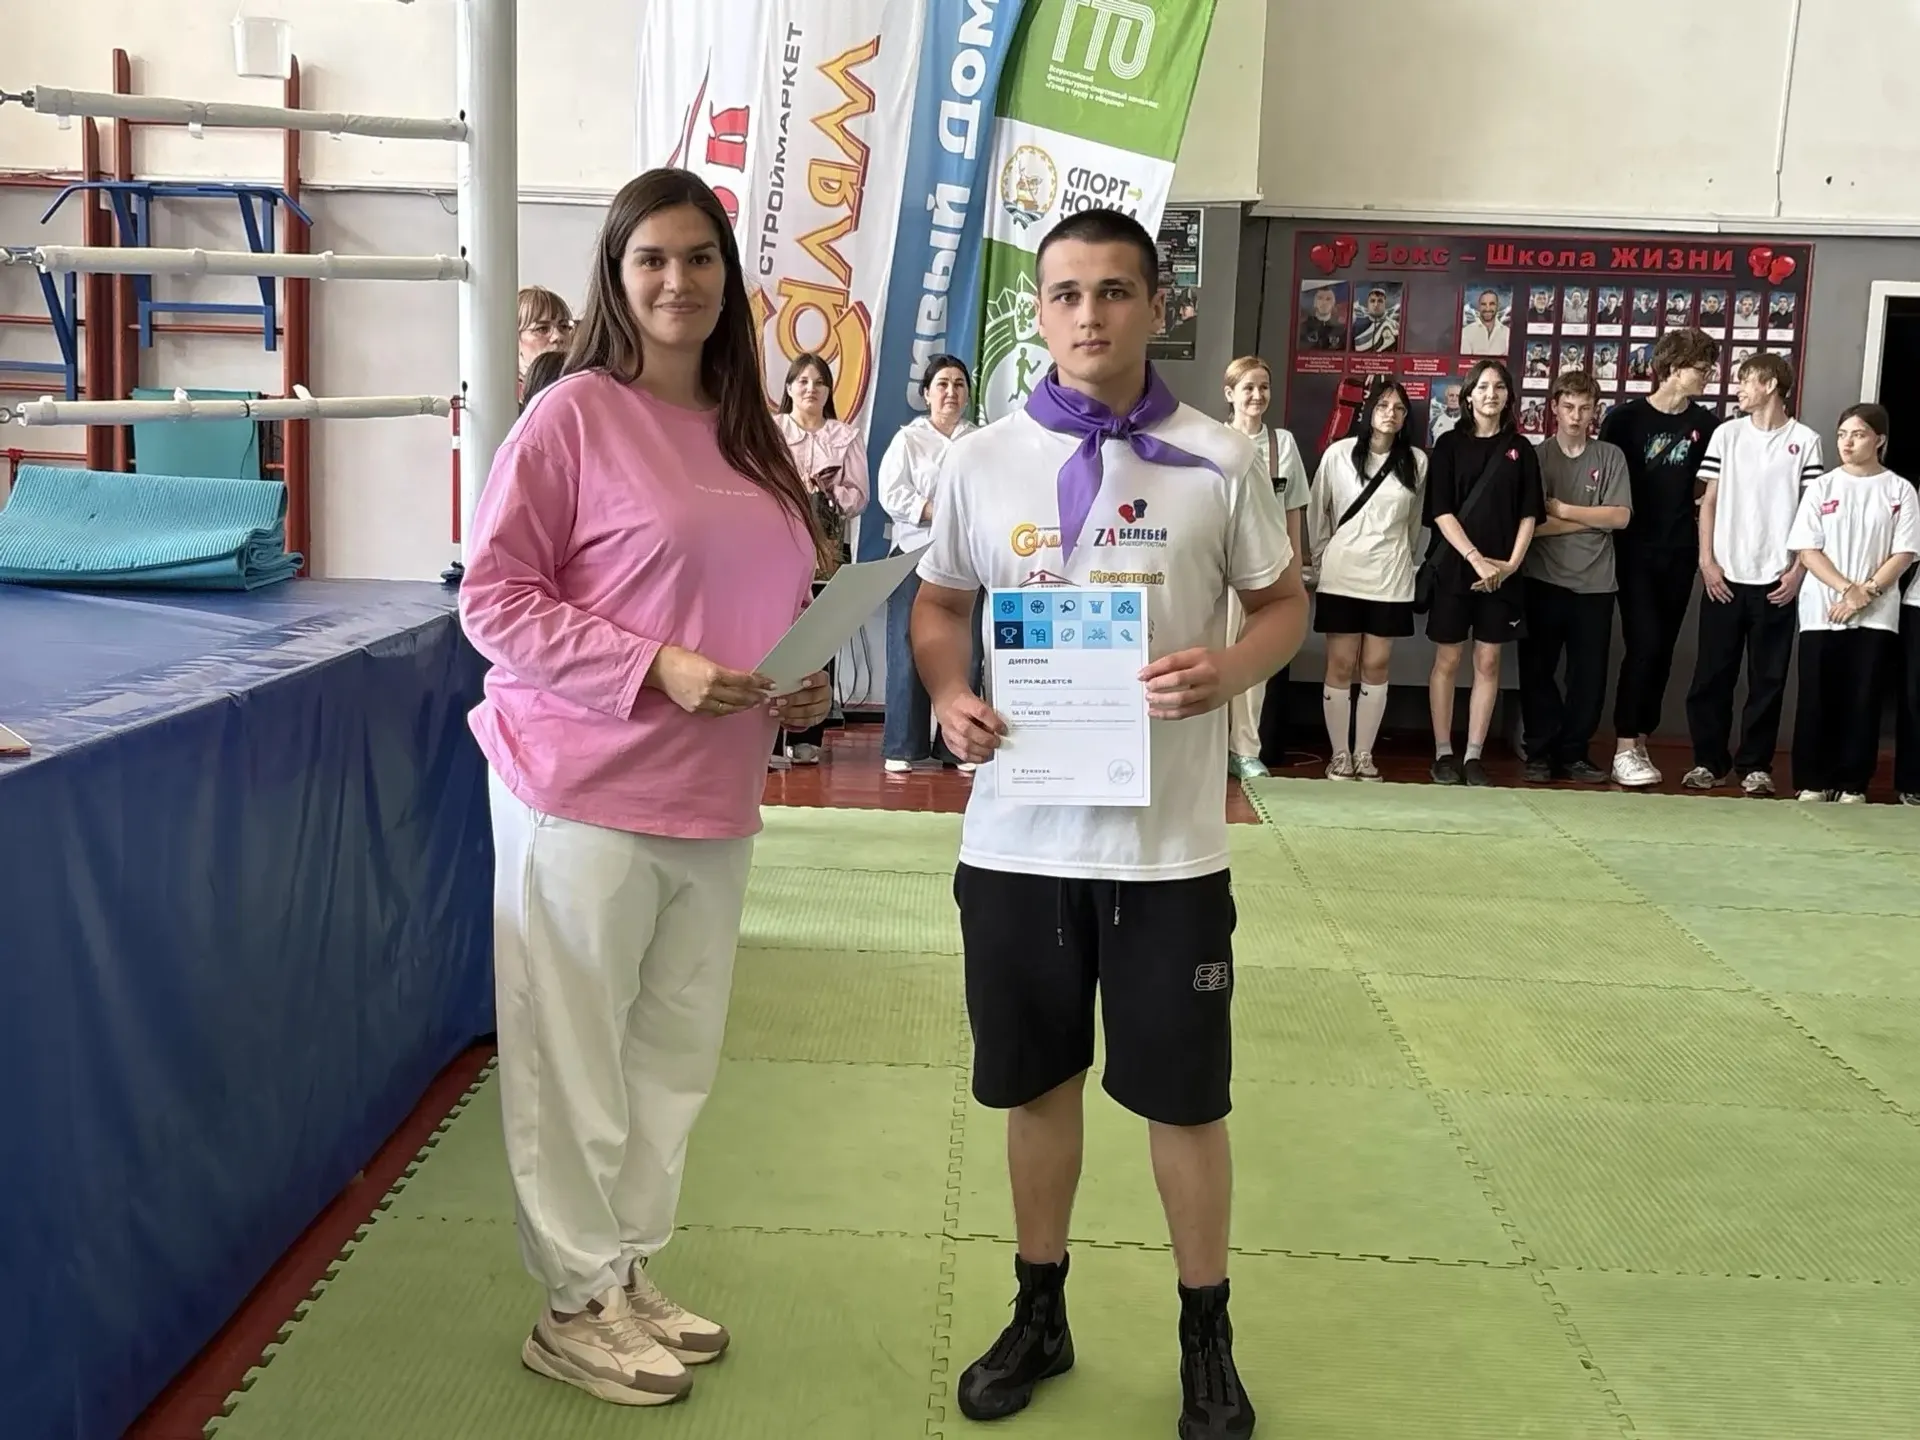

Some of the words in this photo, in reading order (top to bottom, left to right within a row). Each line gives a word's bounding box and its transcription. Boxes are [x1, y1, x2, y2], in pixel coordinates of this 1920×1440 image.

[1052, 0, 1155, 79] ГТО
[759, 22, 803, 275] СТРОЙМАРКЕТ
[1067, 167, 1130, 201] СПОРТ
[1367, 240, 1450, 265] Бокс
[1487, 243, 1596, 268] Школа
[1610, 247, 1734, 271] ЖИЗНИ
[1119, 528, 1168, 541] БЕЛЕБЕЙ
[1089, 570, 1165, 585] Красивый
